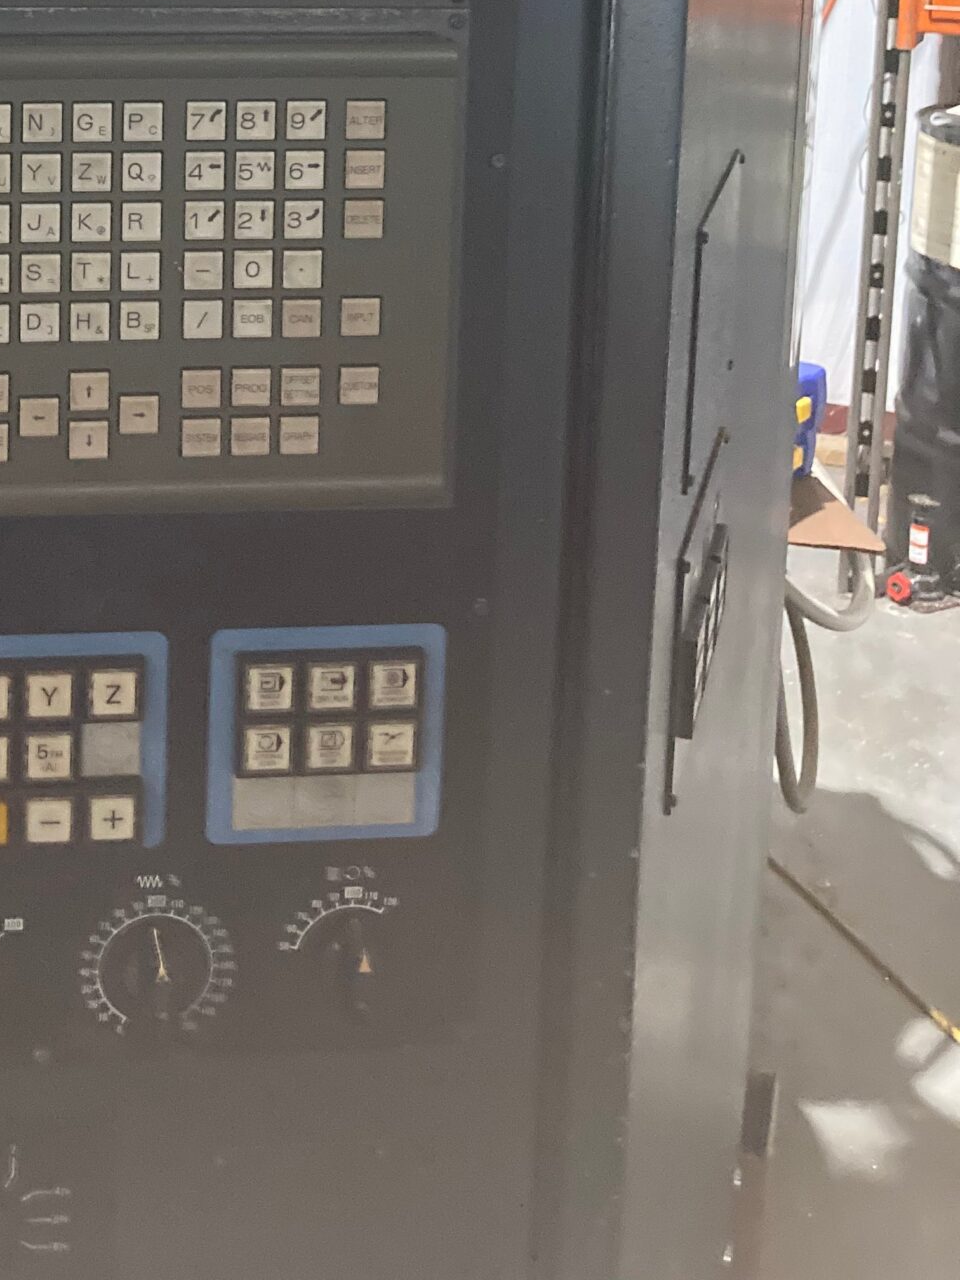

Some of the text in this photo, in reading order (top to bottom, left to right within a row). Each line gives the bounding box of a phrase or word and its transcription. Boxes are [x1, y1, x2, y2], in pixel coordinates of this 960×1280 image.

[27, 113, 44, 132] N
[76, 112, 94, 132] G
[41, 686, 58, 708] Y
[106, 684, 122, 706] Z
